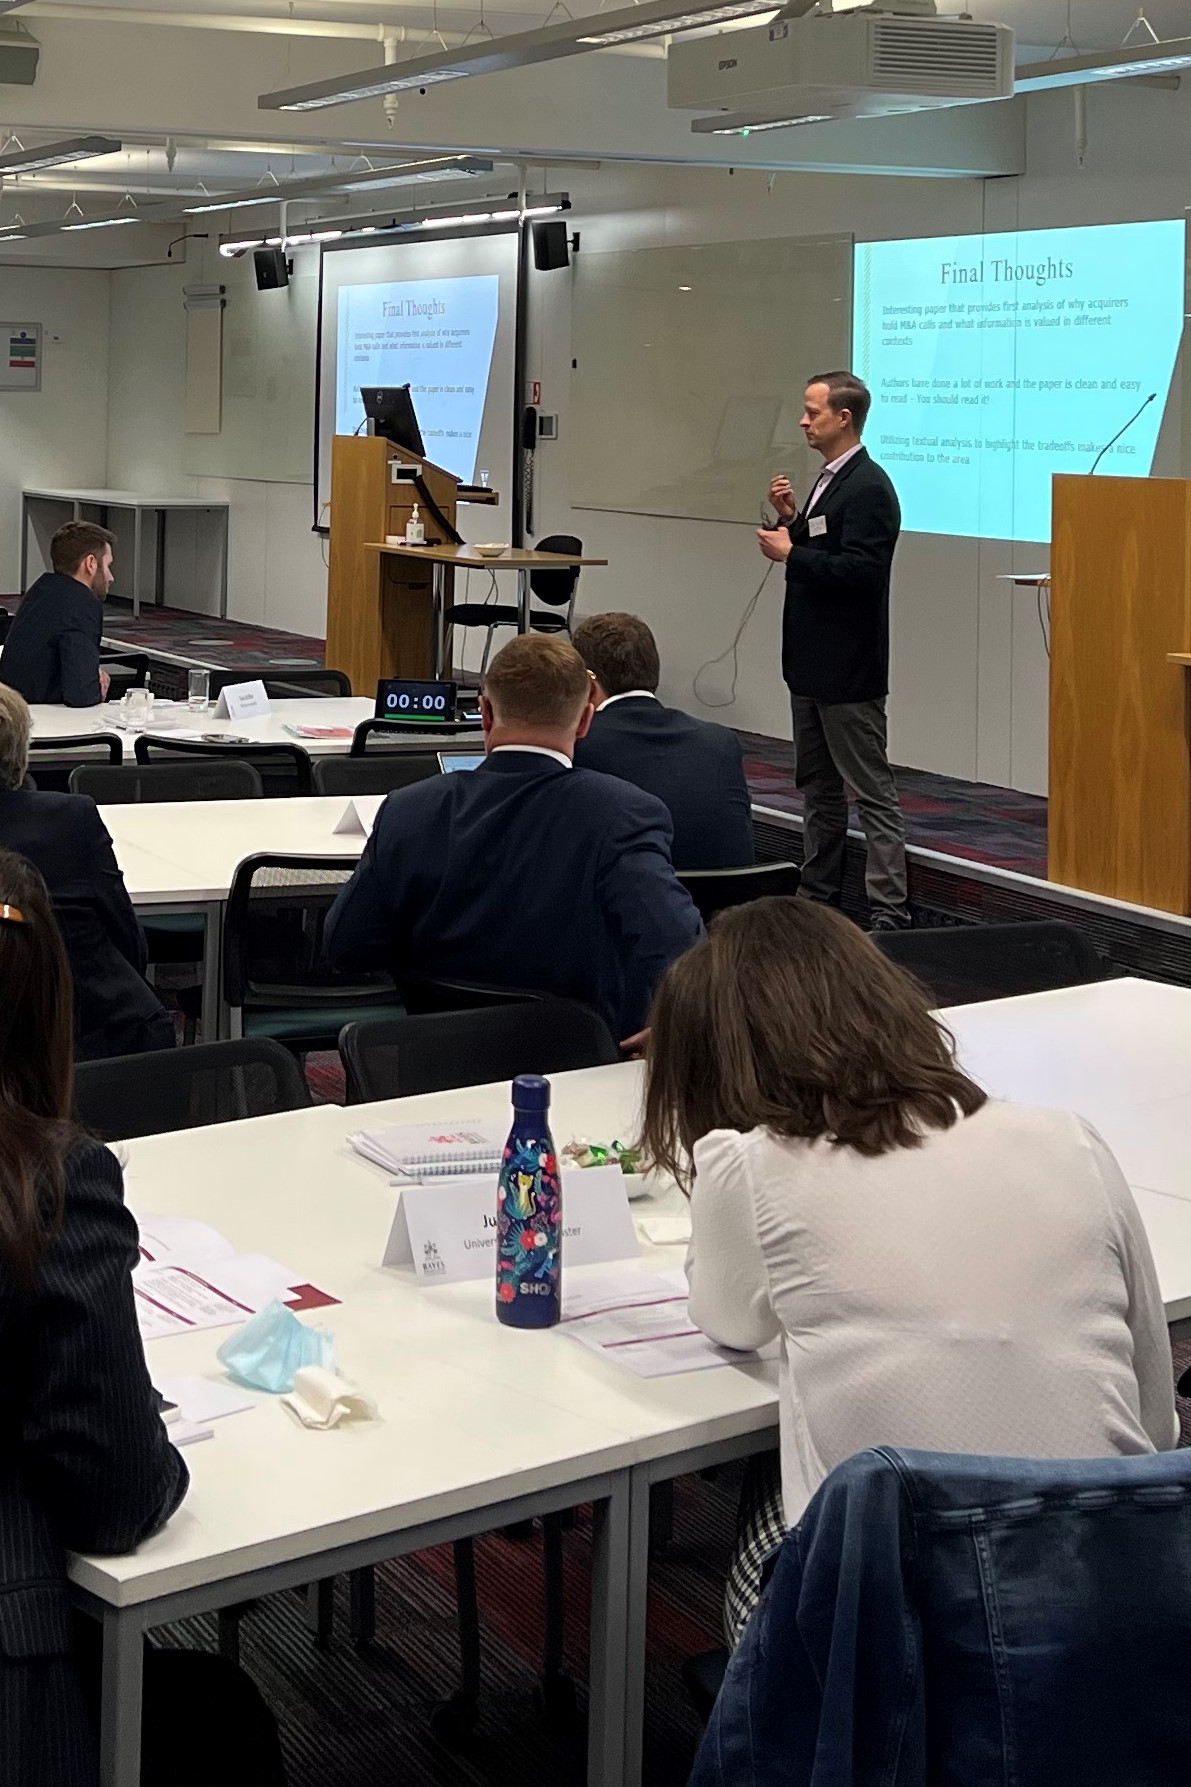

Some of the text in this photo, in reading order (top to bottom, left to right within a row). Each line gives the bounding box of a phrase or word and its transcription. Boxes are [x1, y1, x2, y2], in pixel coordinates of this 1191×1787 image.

[940, 256, 1074, 287] Final Thoughts
[382, 298, 446, 320] Final Thoughts
[882, 298, 1129, 316] Interesting paper that provides first analysis of why acquirers
[900, 320, 917, 330] M&A
[919, 320, 936, 329] calls
[938, 319, 953, 329] and
[955, 318, 975, 328] what
[977, 318, 1022, 328] information
[1024, 317, 1032, 327] is
[1034, 316, 1061, 327] valued
[1063, 316, 1072, 326] in
[1074, 315, 1112, 326] different
[881, 378, 1142, 392] Authors have done a lot of work and the paper is clean and easy
[881, 394, 889, 403] to
[890, 393, 908, 403] read
[916, 394, 931, 403] You
[933, 393, 959, 404] should
[961, 395, 979, 404] read
[880, 434, 910, 448] Utilizing
[912, 436, 939, 447] textual
[940, 437, 973, 450] analysis
[974, 439, 983, 448] to
[985, 438, 1020, 452] highlight
[1022, 439, 1035, 450] the
[1037, 440, 1076, 452] tradeoffs
[1116, 443, 1136, 454] nice
[880, 451, 970, 465] contribution to the area
[386, 693, 446, 710] 00:00
[483, 1214, 497, 1228] Ju
[463, 1226, 581, 1250] Univer ster
